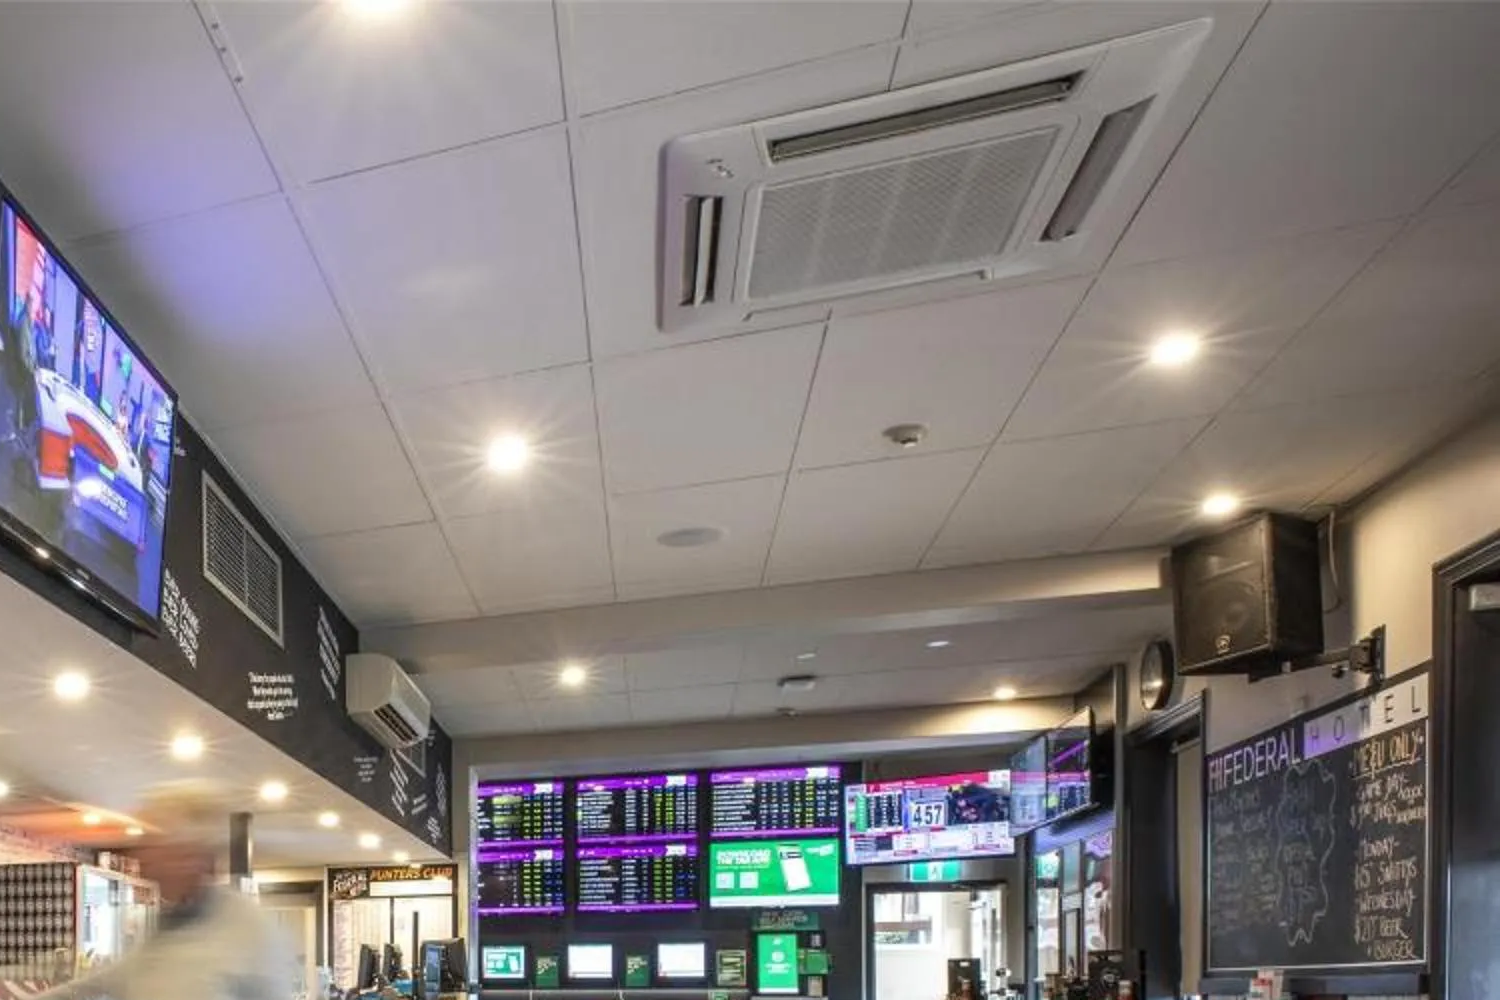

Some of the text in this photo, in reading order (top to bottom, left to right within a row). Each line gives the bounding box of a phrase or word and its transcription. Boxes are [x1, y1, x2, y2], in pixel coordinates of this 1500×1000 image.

[1223, 727, 1301, 789] FEDERAL
[1308, 685, 1421, 746] HOTEL
[370, 866, 453, 881] PUNTERS CLUB
